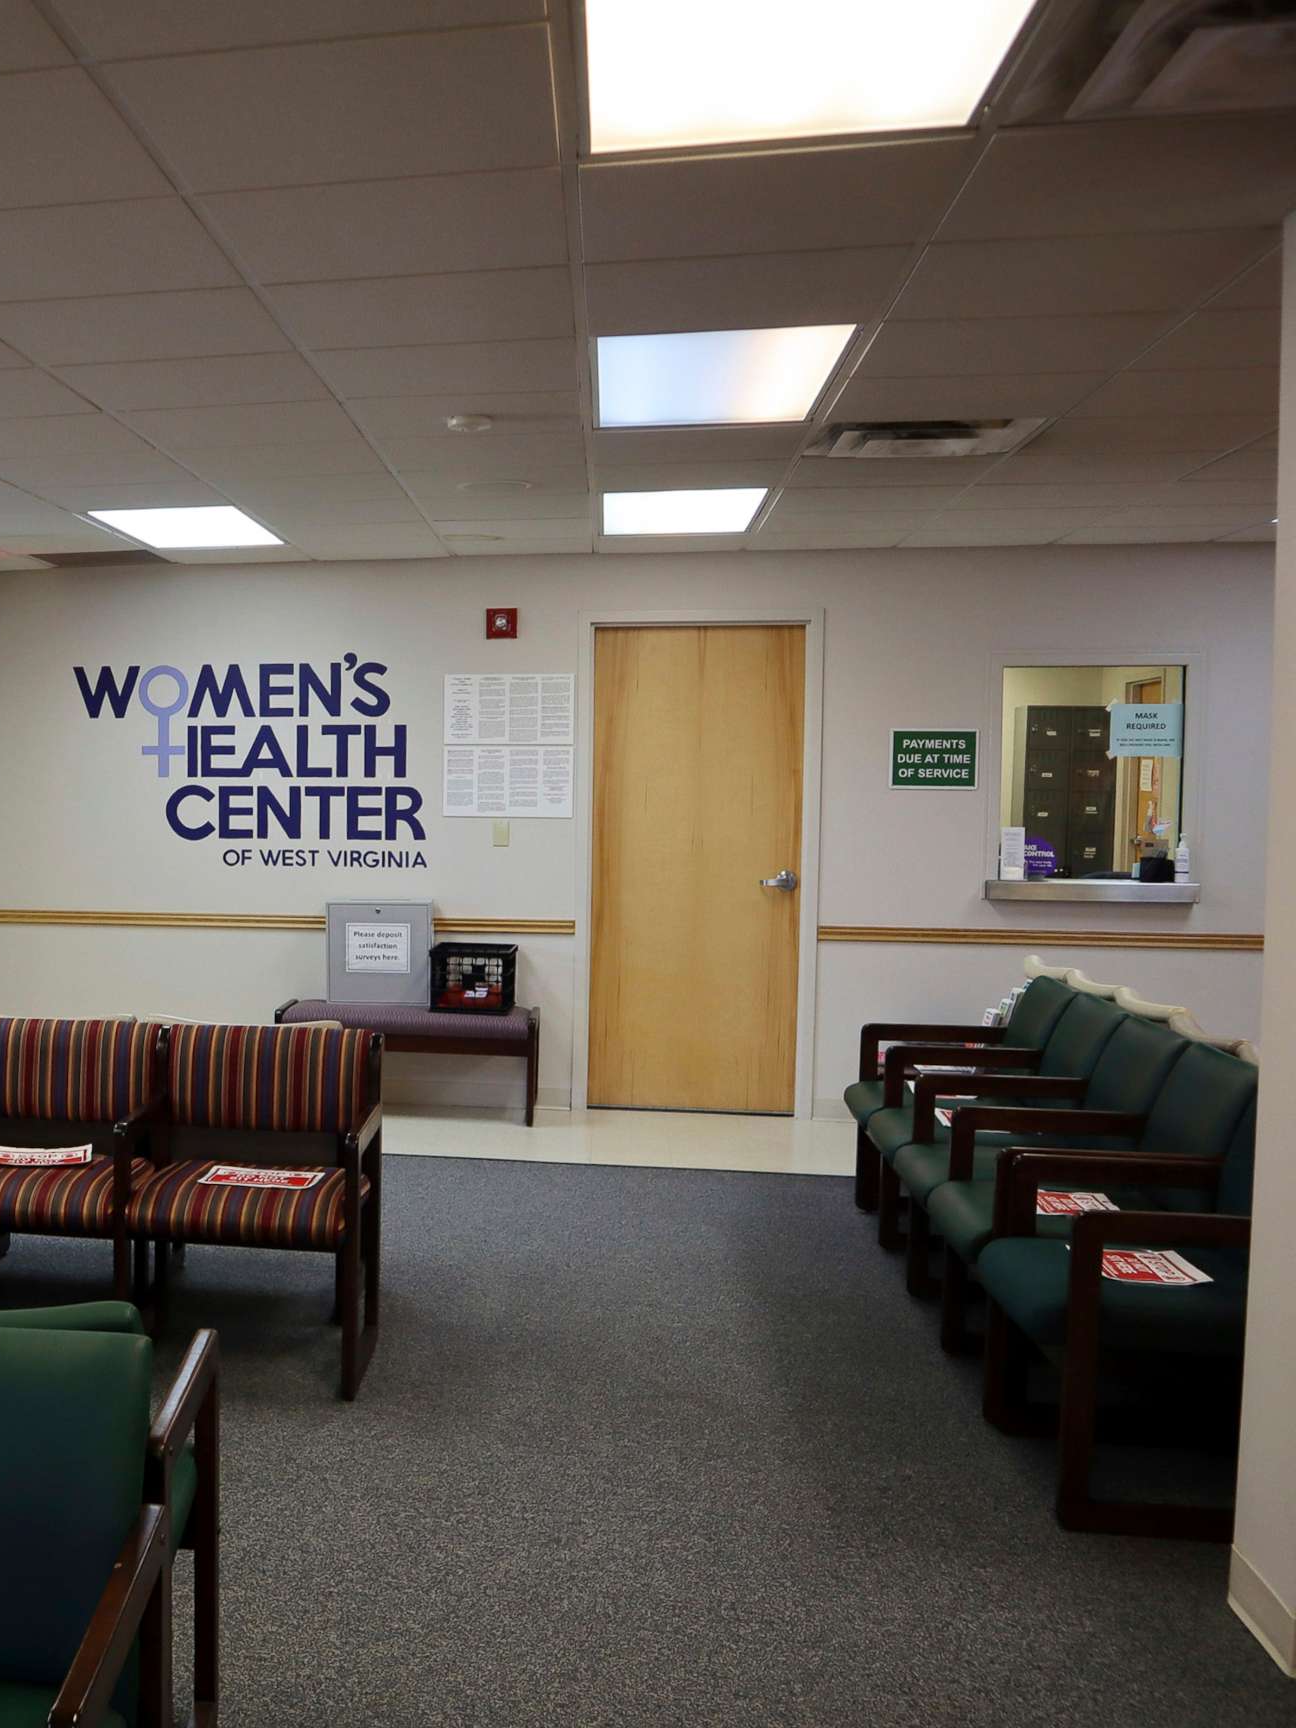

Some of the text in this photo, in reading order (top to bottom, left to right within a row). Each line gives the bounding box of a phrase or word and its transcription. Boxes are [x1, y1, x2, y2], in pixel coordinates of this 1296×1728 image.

[903, 739, 966, 749] PAYMENTS
[897, 754, 971, 764] DUE AT TIME
[898, 768, 969, 778] OF SERVICE
[165, 784, 427, 841] CENTER
[222, 849, 428, 869] OF WEST VIRGINIA
[377, 931, 402, 939] deposit
[355, 953, 381, 962] surveys
